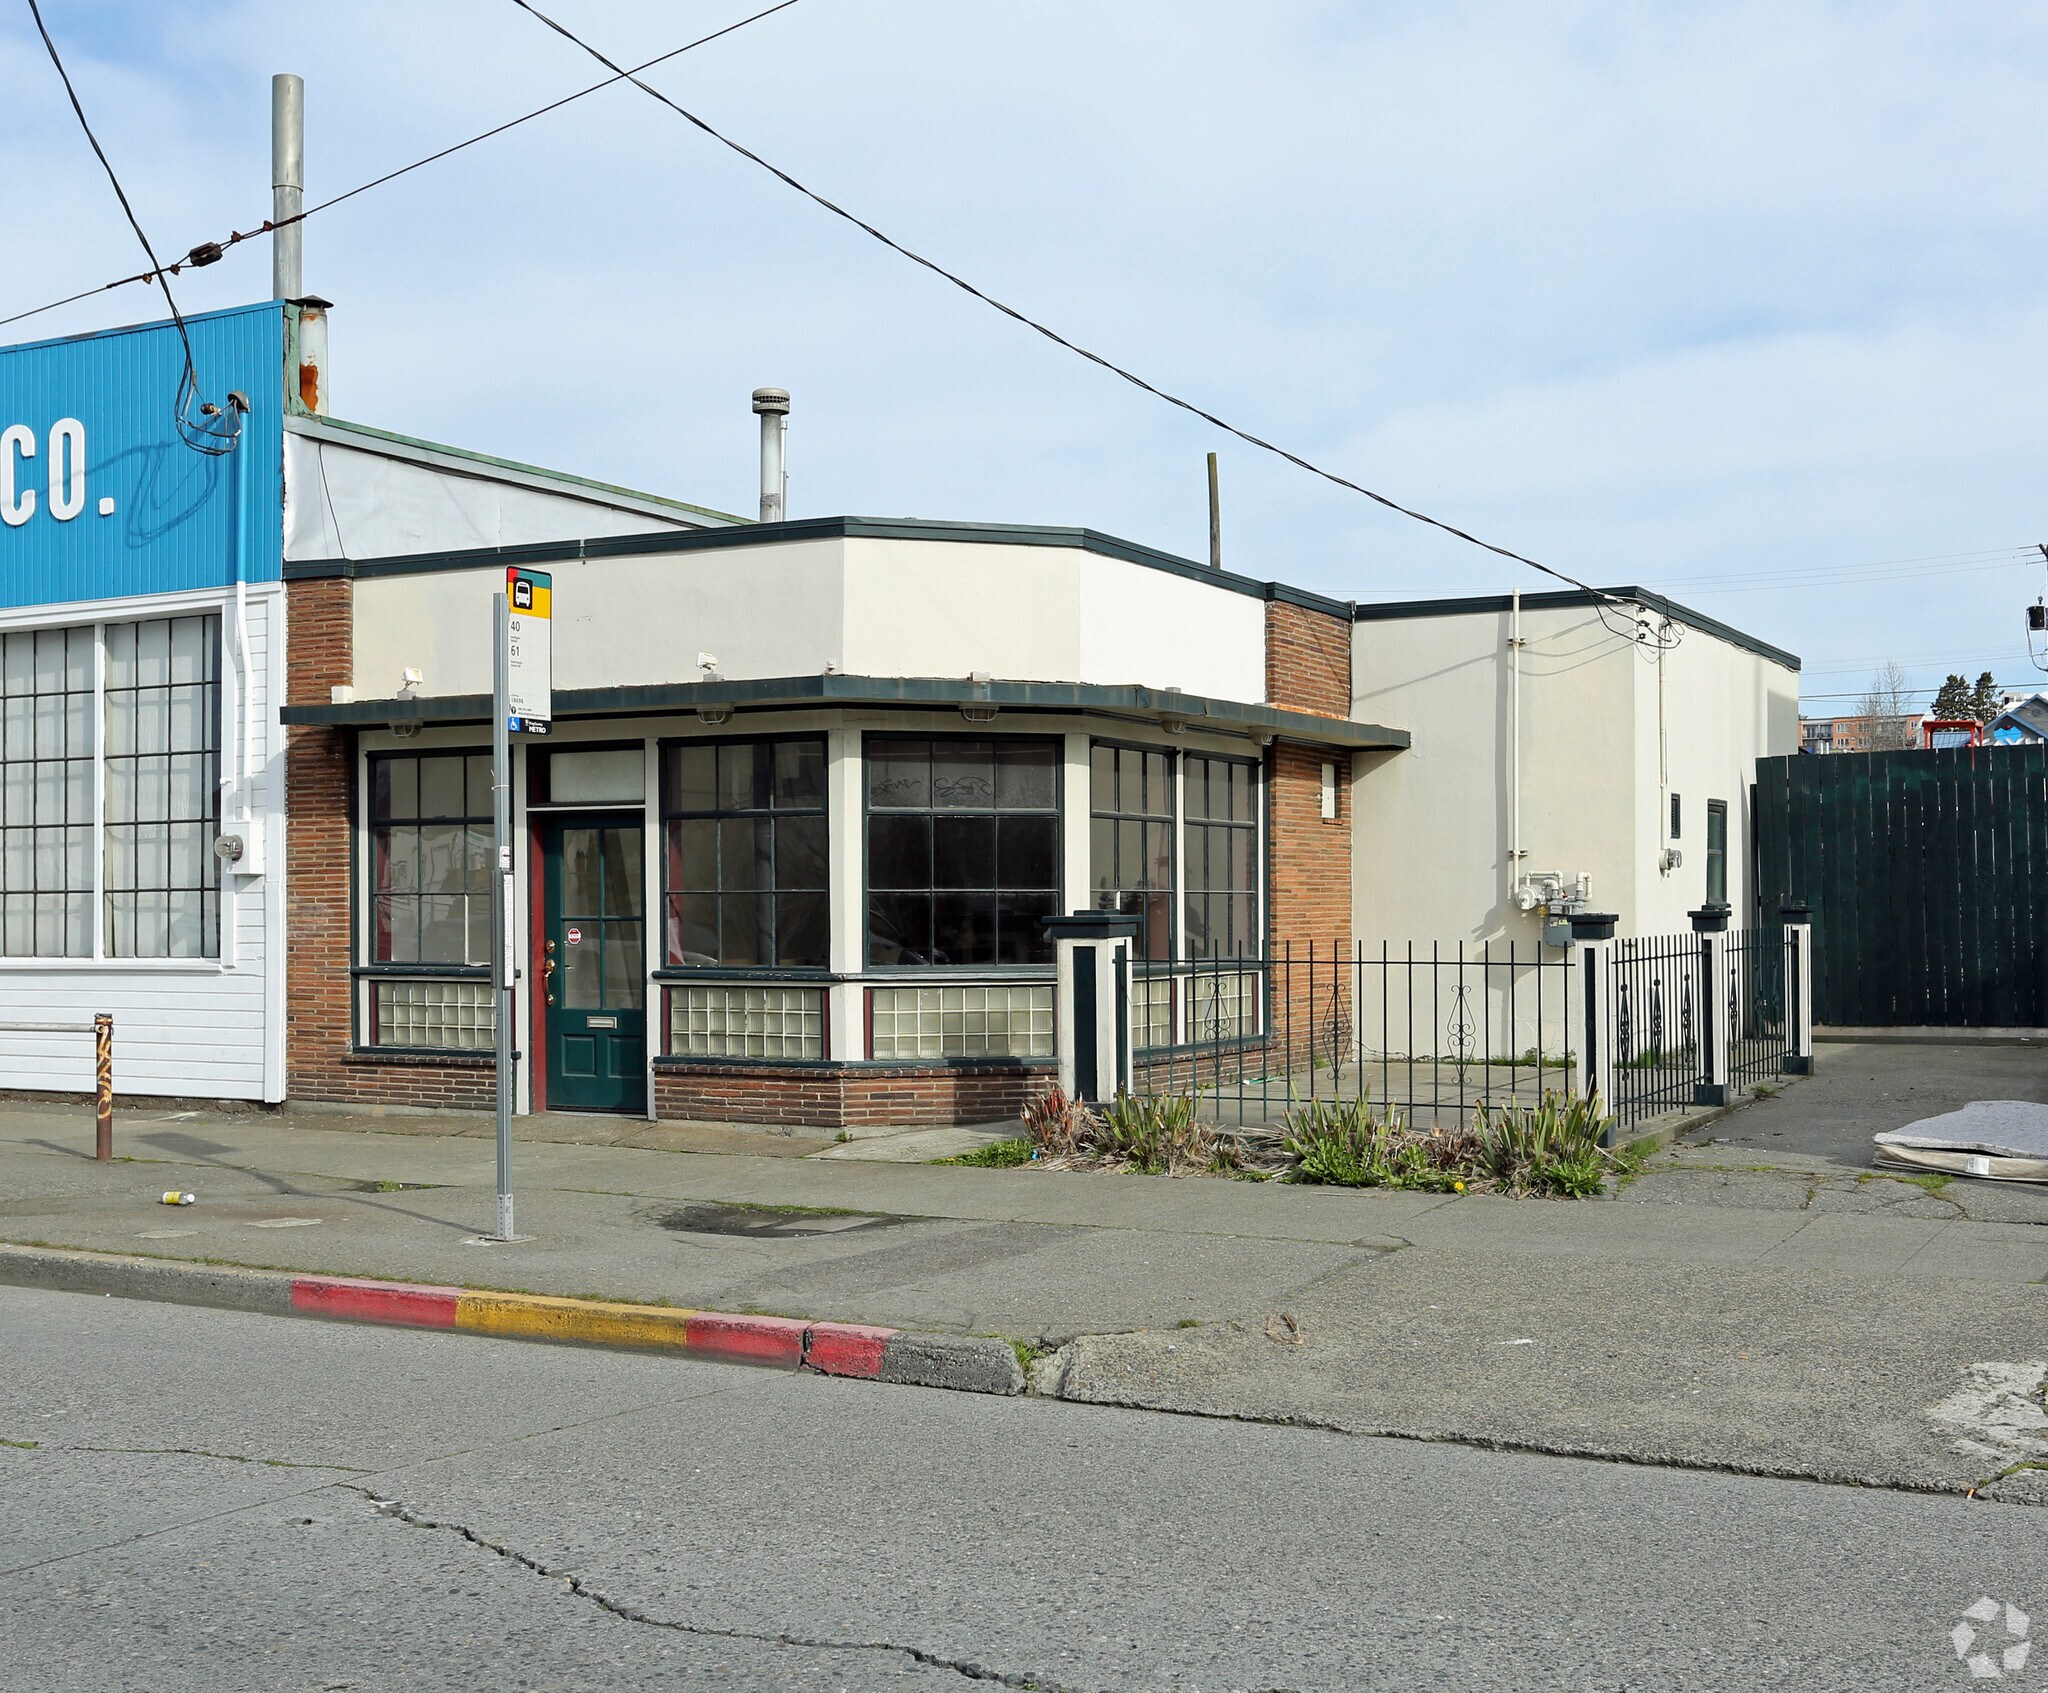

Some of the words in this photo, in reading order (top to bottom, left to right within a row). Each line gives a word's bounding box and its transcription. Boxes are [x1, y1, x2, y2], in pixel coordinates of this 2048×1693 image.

[0, 418, 115, 526] CO.
[510, 620, 520, 632] 40
[511, 645, 520, 656] 61
[528, 726, 547, 734] METRO
